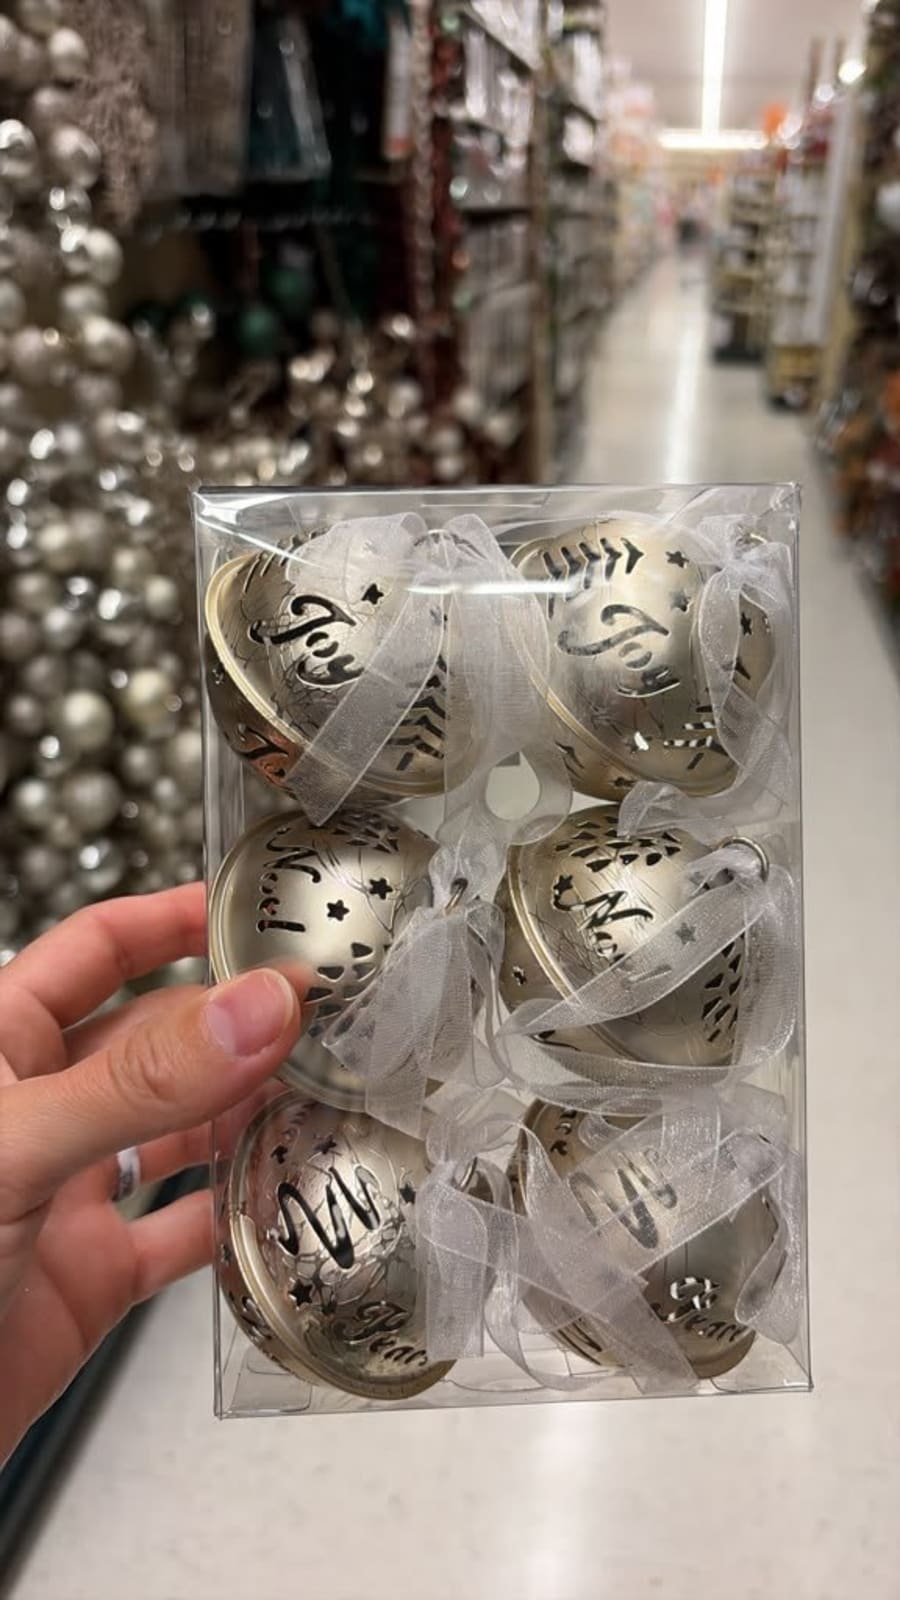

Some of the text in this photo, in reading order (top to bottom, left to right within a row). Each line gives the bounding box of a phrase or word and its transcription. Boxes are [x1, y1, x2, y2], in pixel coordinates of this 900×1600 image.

[249, 594, 365, 685] Joy
[557, 604, 681, 697] Joy
[257, 827, 322, 933] Noel
